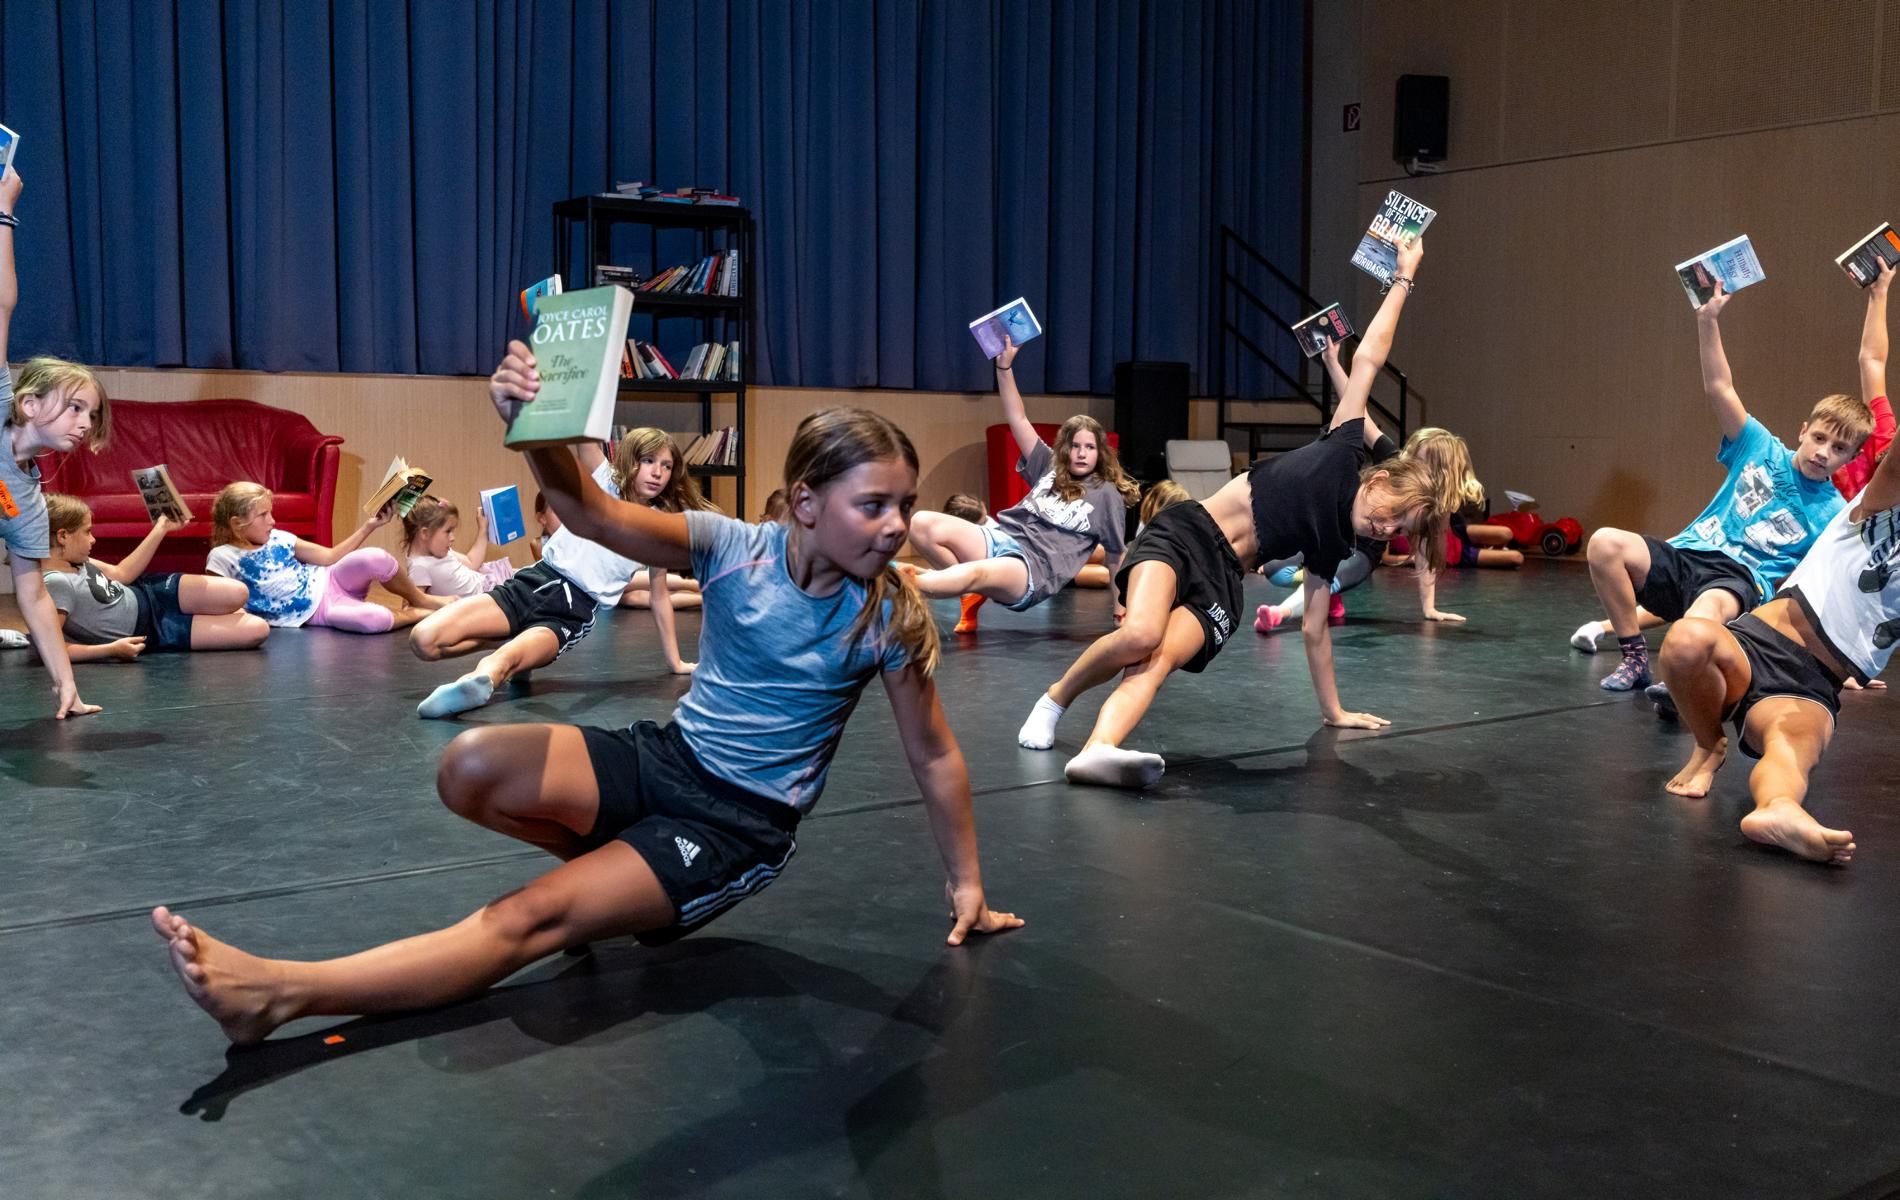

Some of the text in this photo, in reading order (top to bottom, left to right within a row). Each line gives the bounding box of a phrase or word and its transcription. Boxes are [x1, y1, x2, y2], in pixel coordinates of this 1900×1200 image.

[1385, 191, 1428, 224] SILENCE
[1385, 208, 1408, 226] OF THE
[1370, 214, 1417, 246] GRAVE
[1352, 254, 1391, 279] INDRIDASON
[1735, 249, 1752, 279] Hillbilly
[537, 306, 607, 325] JOYCE CAROL
[533, 317, 607, 344] OATES
[551, 355, 572, 368] The
[539, 365, 589, 385] Sacrifice
[1207, 603, 1225, 622] LOS
